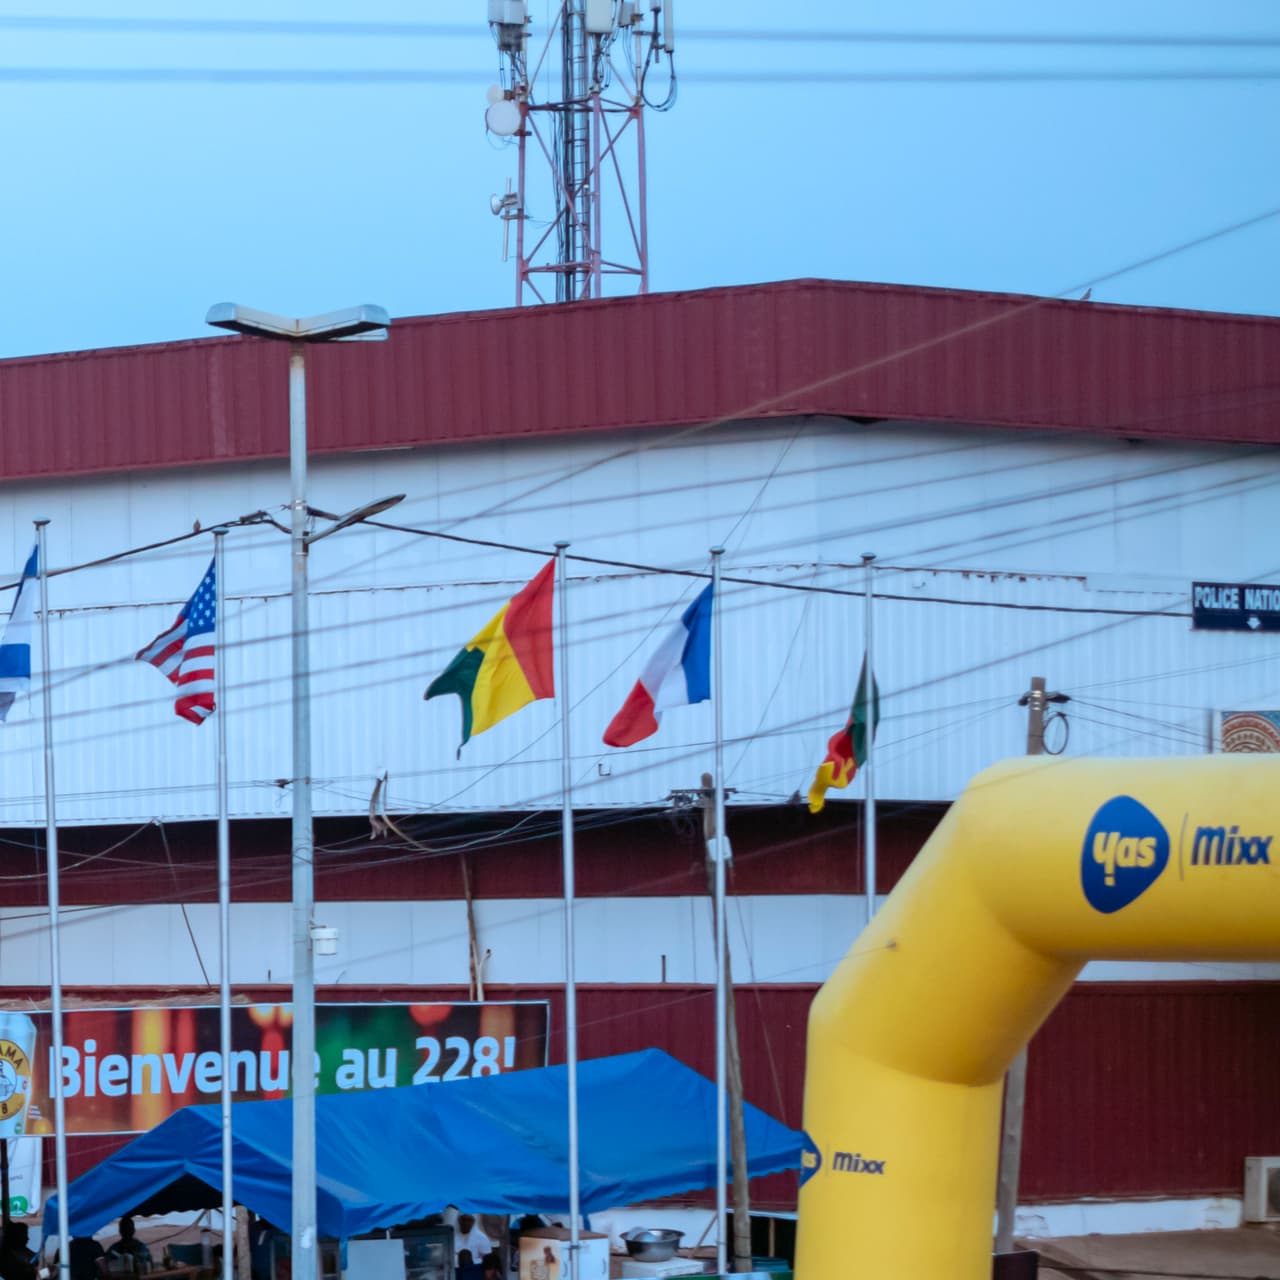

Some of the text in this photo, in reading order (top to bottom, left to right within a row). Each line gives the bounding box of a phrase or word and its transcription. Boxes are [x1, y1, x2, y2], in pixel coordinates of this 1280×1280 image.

[1195, 587, 1239, 609] POLICE
[48, 1038, 321, 1098] Bienvenu
[336, 1048, 397, 1089] au
